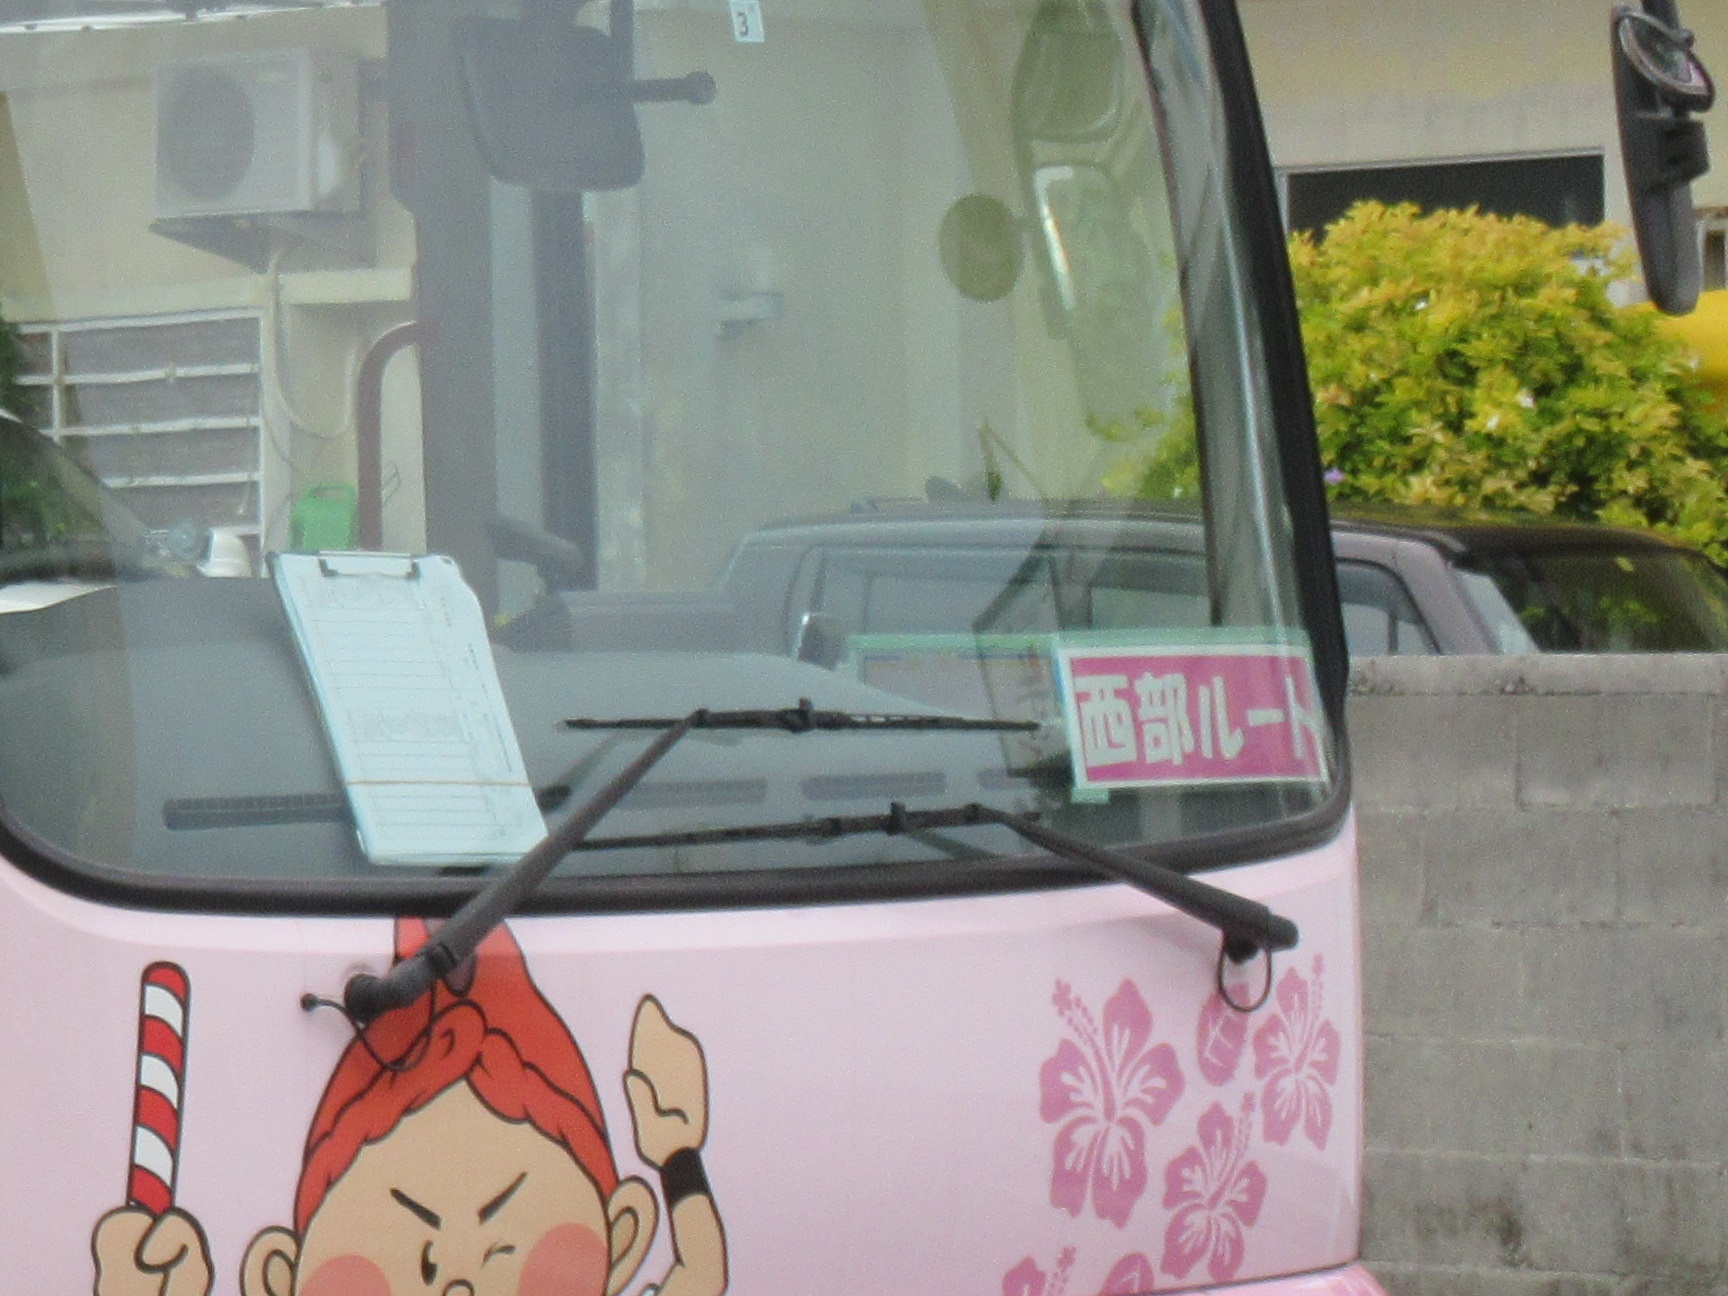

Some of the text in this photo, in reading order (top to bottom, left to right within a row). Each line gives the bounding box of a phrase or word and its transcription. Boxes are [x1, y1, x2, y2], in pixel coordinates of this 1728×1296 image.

[1074, 671, 1322, 768] 西部ルート
